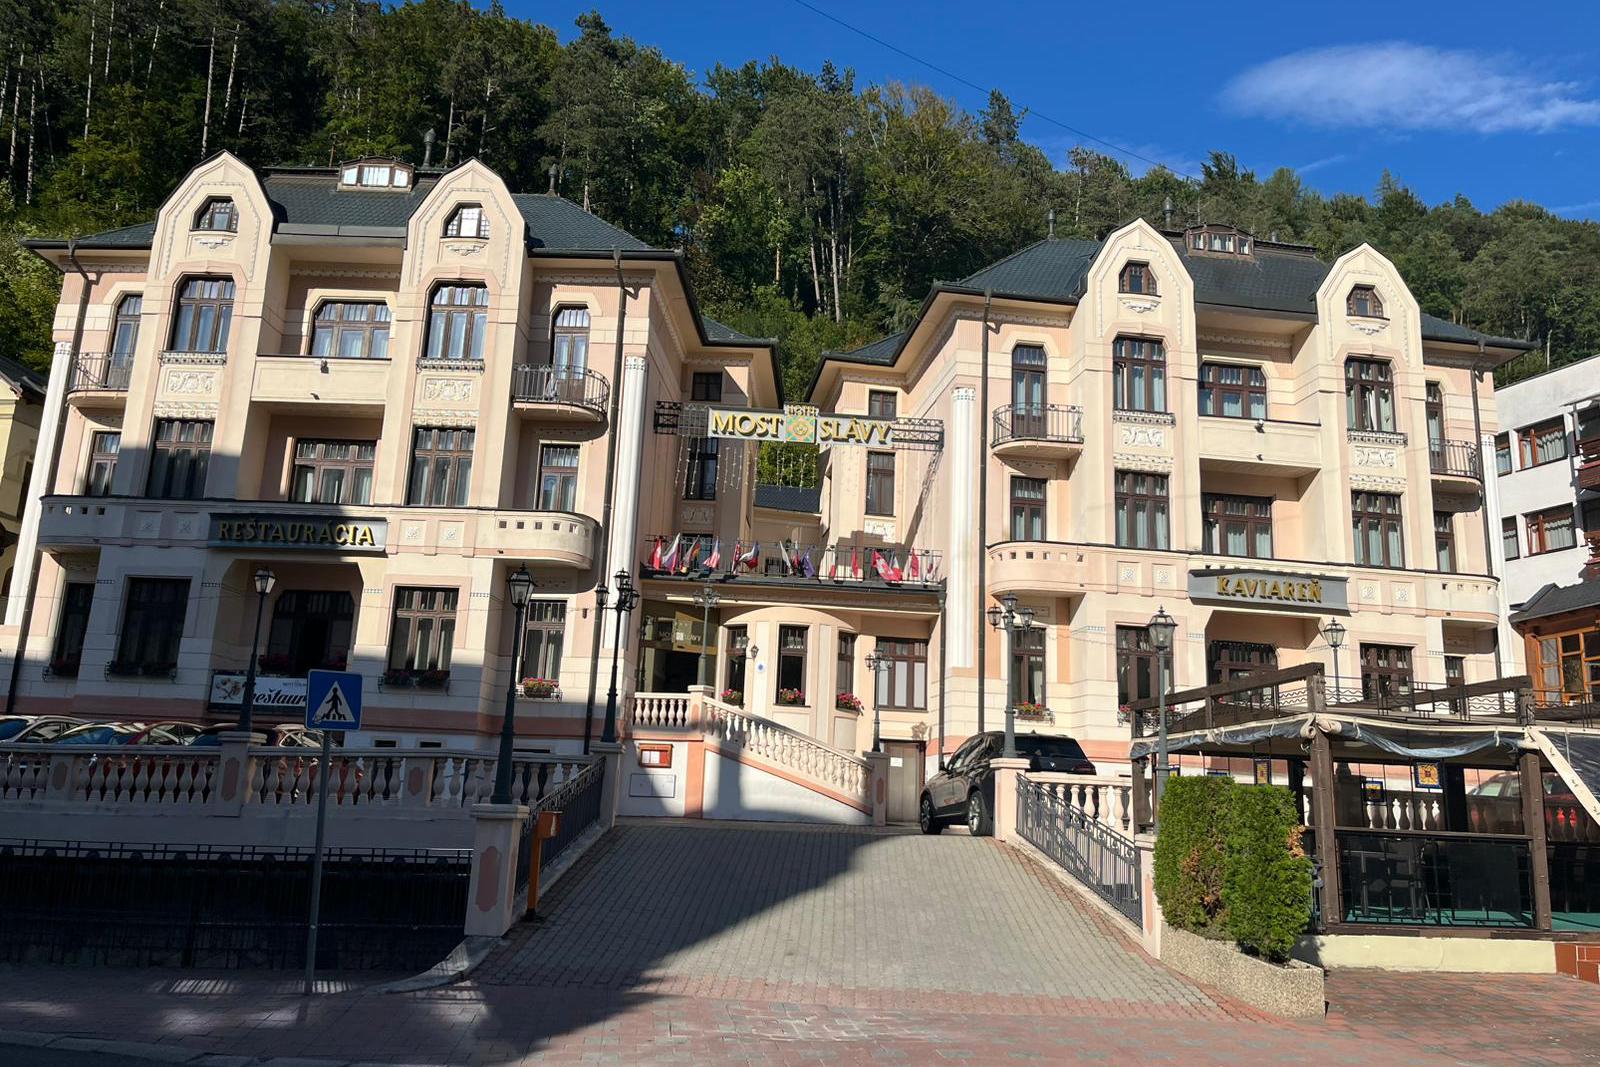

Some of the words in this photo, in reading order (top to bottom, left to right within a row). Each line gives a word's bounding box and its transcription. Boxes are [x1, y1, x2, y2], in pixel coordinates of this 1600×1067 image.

[712, 412, 783, 437] MOST
[819, 417, 893, 444] SLÁVY
[218, 517, 376, 546] REŠTAURÁCIA
[1217, 577, 1322, 603] KAVIAREŇ
[251, 688, 306, 704] eštaur
